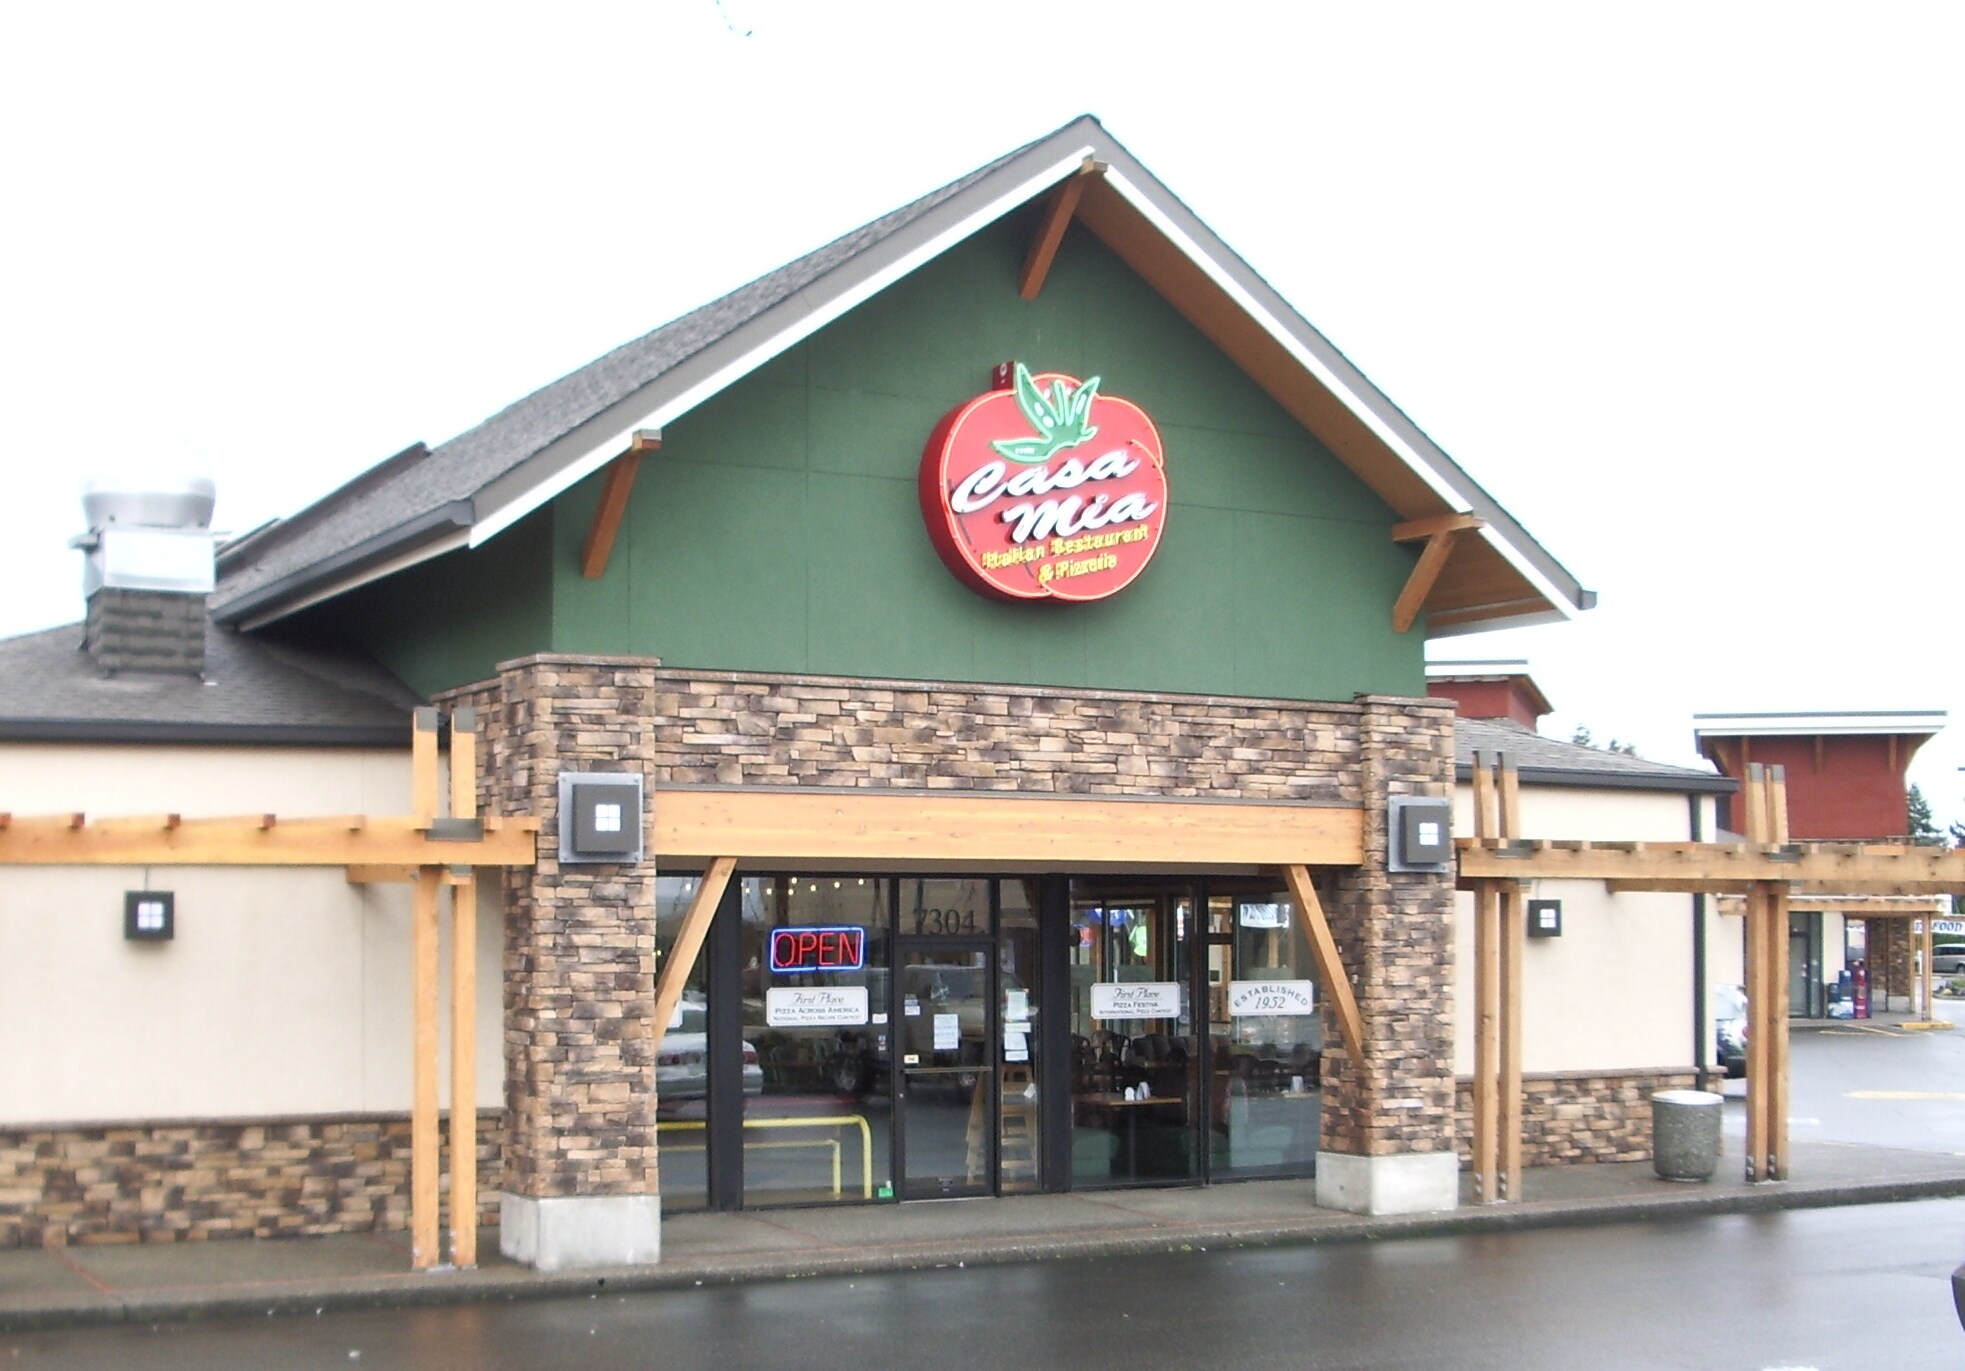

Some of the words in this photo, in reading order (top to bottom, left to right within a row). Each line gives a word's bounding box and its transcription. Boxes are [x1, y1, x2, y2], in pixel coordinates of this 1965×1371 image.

[951, 449, 1140, 513] Casa
[1002, 492, 1158, 543] Mia
[982, 543, 1045, 569] Italian
[1050, 524, 1148, 556] Restaurant
[1037, 563, 1053, 584] &
[1056, 552, 1118, 579] Pizzeria
[912, 907, 977, 936] 7304
[774, 931, 861, 967] OPEN
[794, 992, 815, 1004] First
[1113, 987, 1135, 999] First
[1136, 987, 1160, 998] Place
[1234, 985, 1308, 1007] ESTABLISHED
[1255, 996, 1286, 1009] 1952
